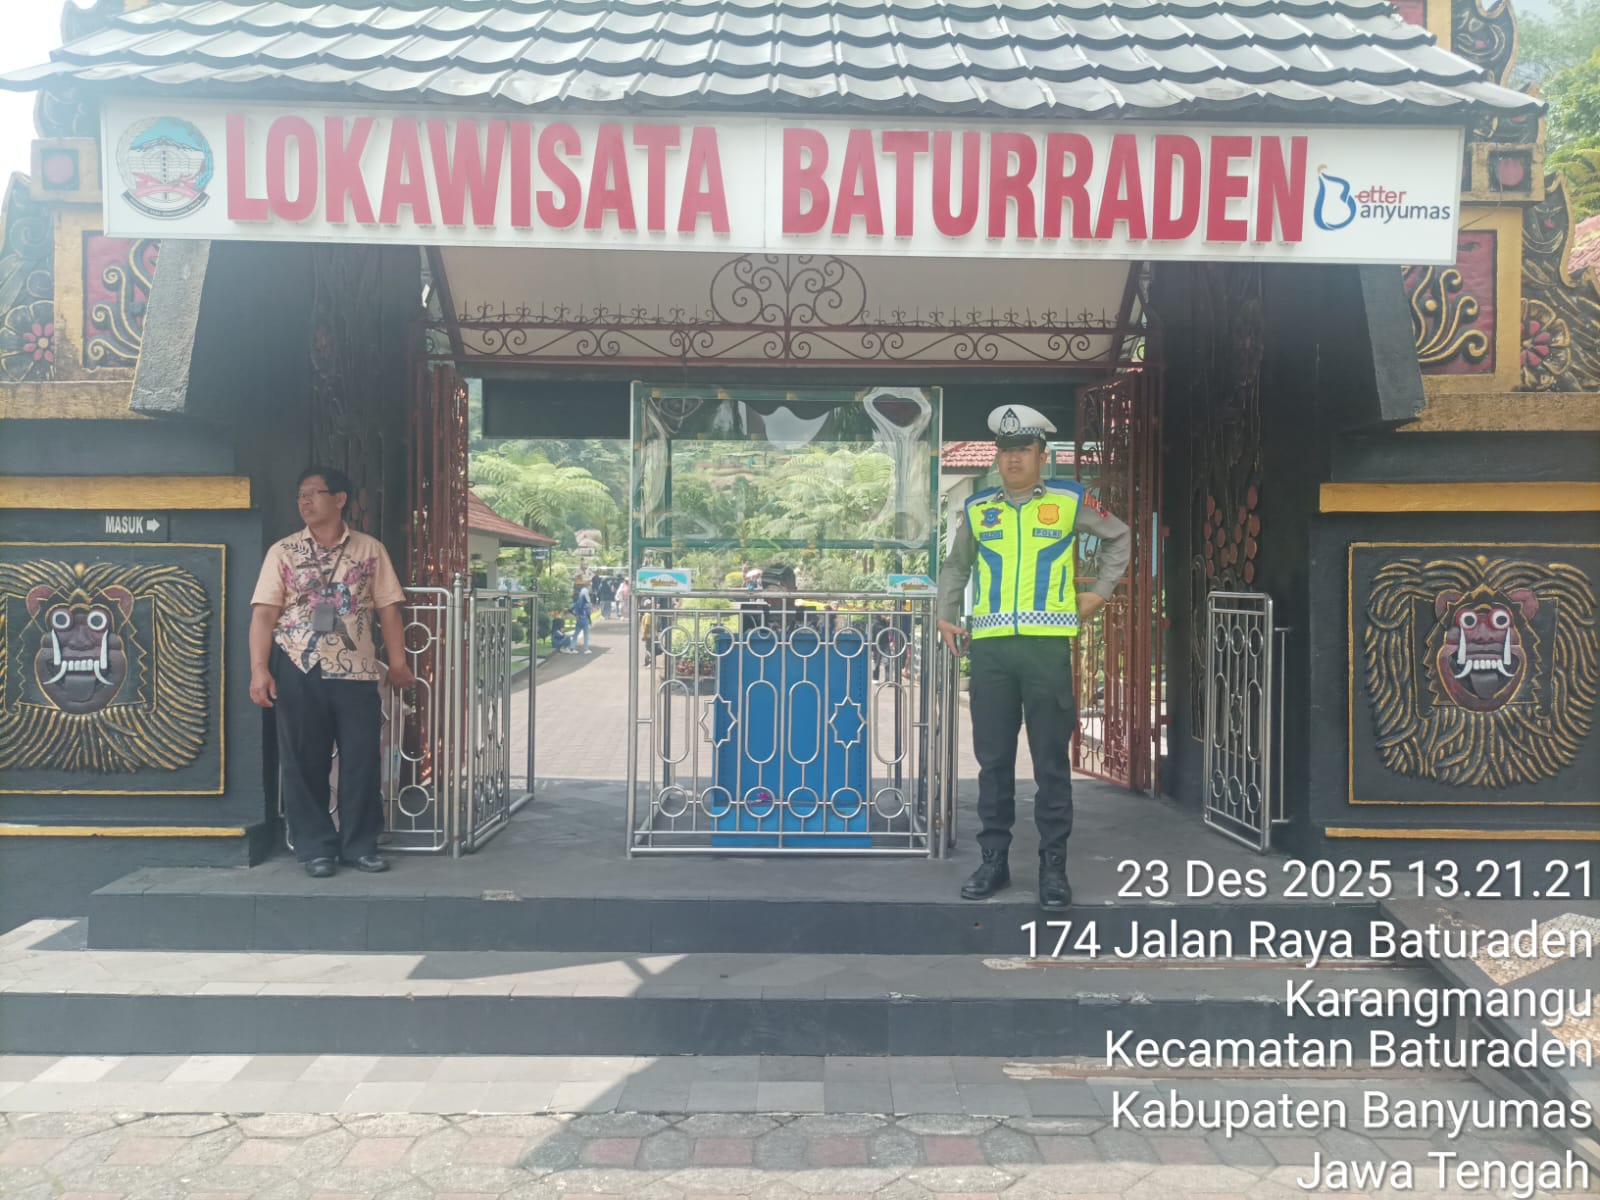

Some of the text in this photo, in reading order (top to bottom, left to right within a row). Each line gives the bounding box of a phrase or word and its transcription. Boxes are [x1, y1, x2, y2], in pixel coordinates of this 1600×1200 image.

[225, 113, 1308, 243] LOKAWISATA BATURRADEN
[105, 515, 144, 534] MASUK
